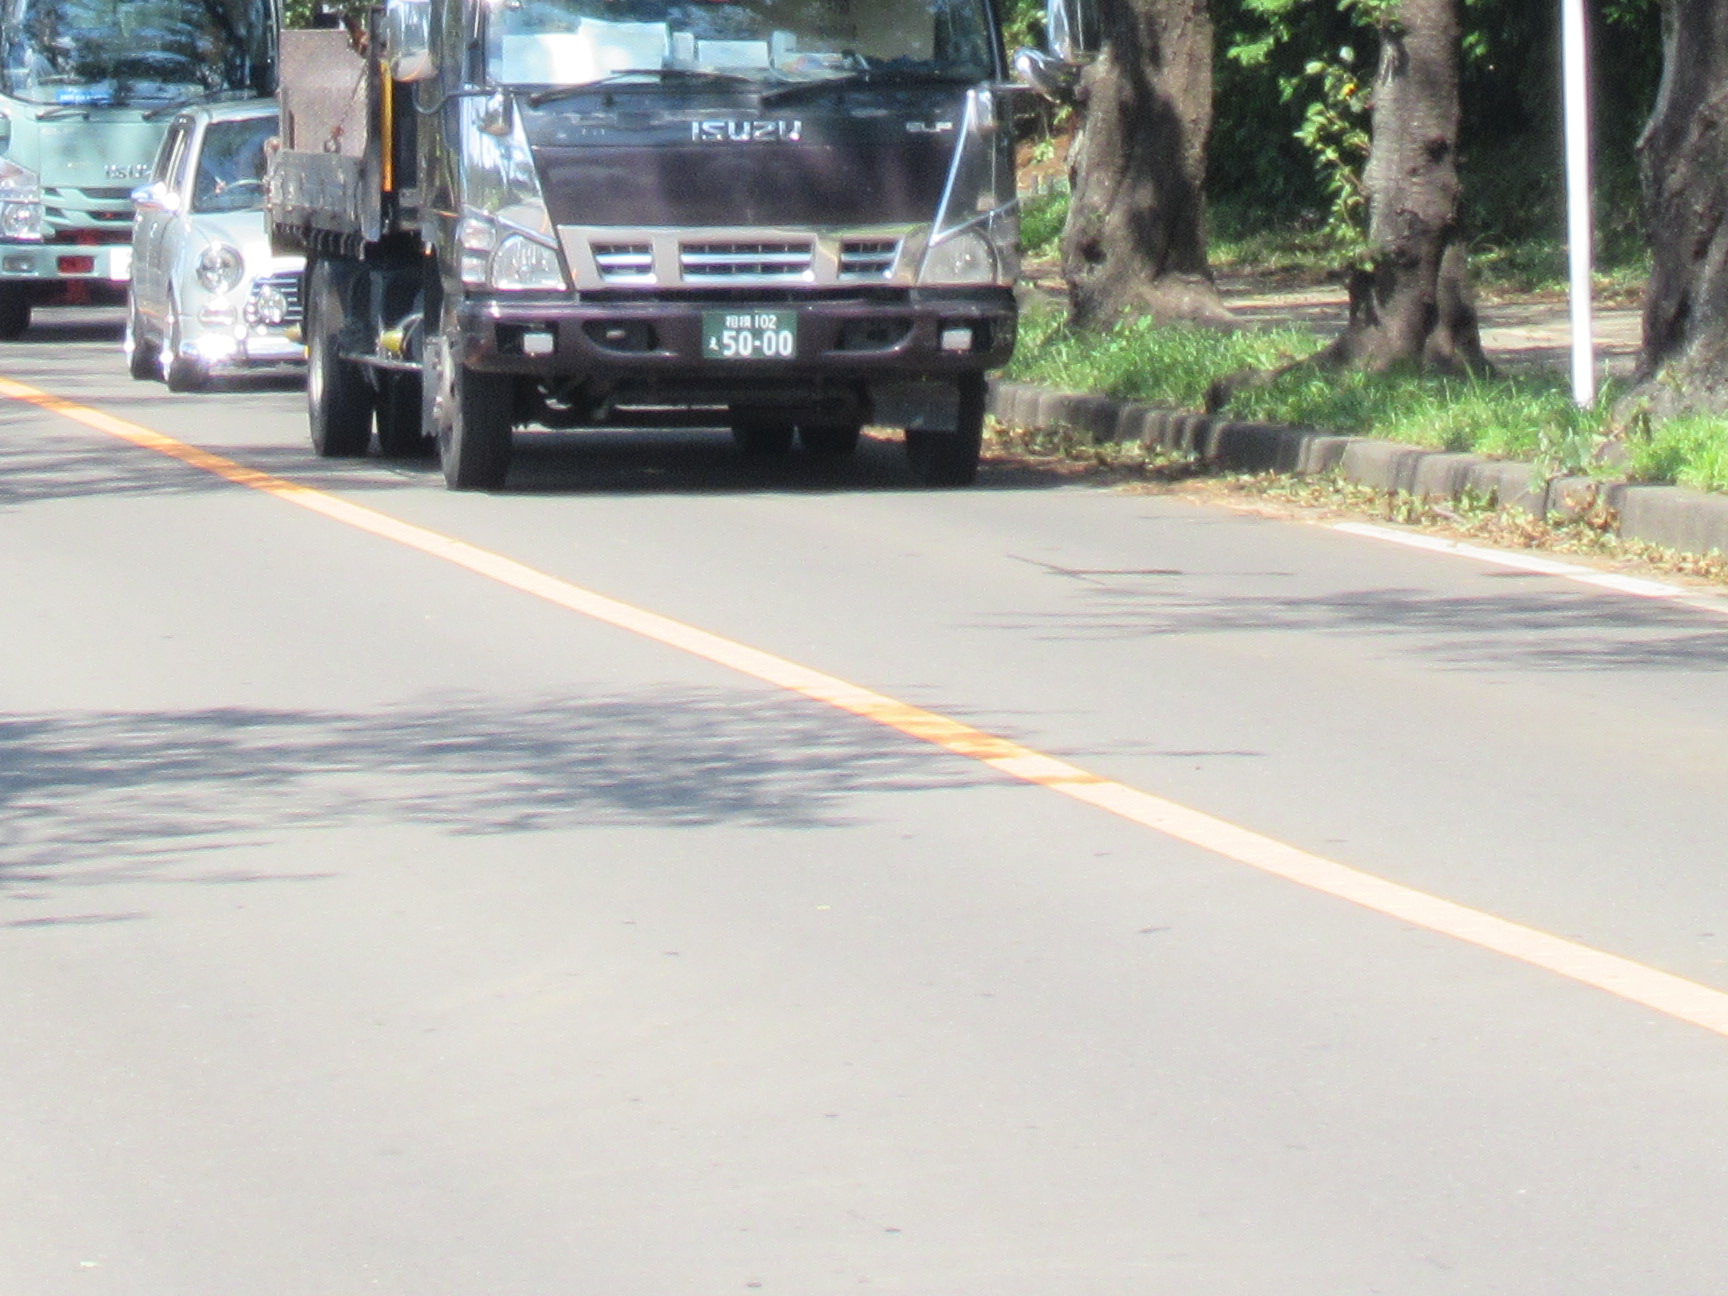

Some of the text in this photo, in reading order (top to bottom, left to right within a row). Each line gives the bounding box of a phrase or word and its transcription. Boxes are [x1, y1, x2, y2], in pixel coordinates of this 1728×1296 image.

[691, 119, 802, 141] ISUZU
[754, 314, 777, 328] 102
[722, 330, 793, 356] 50-00
